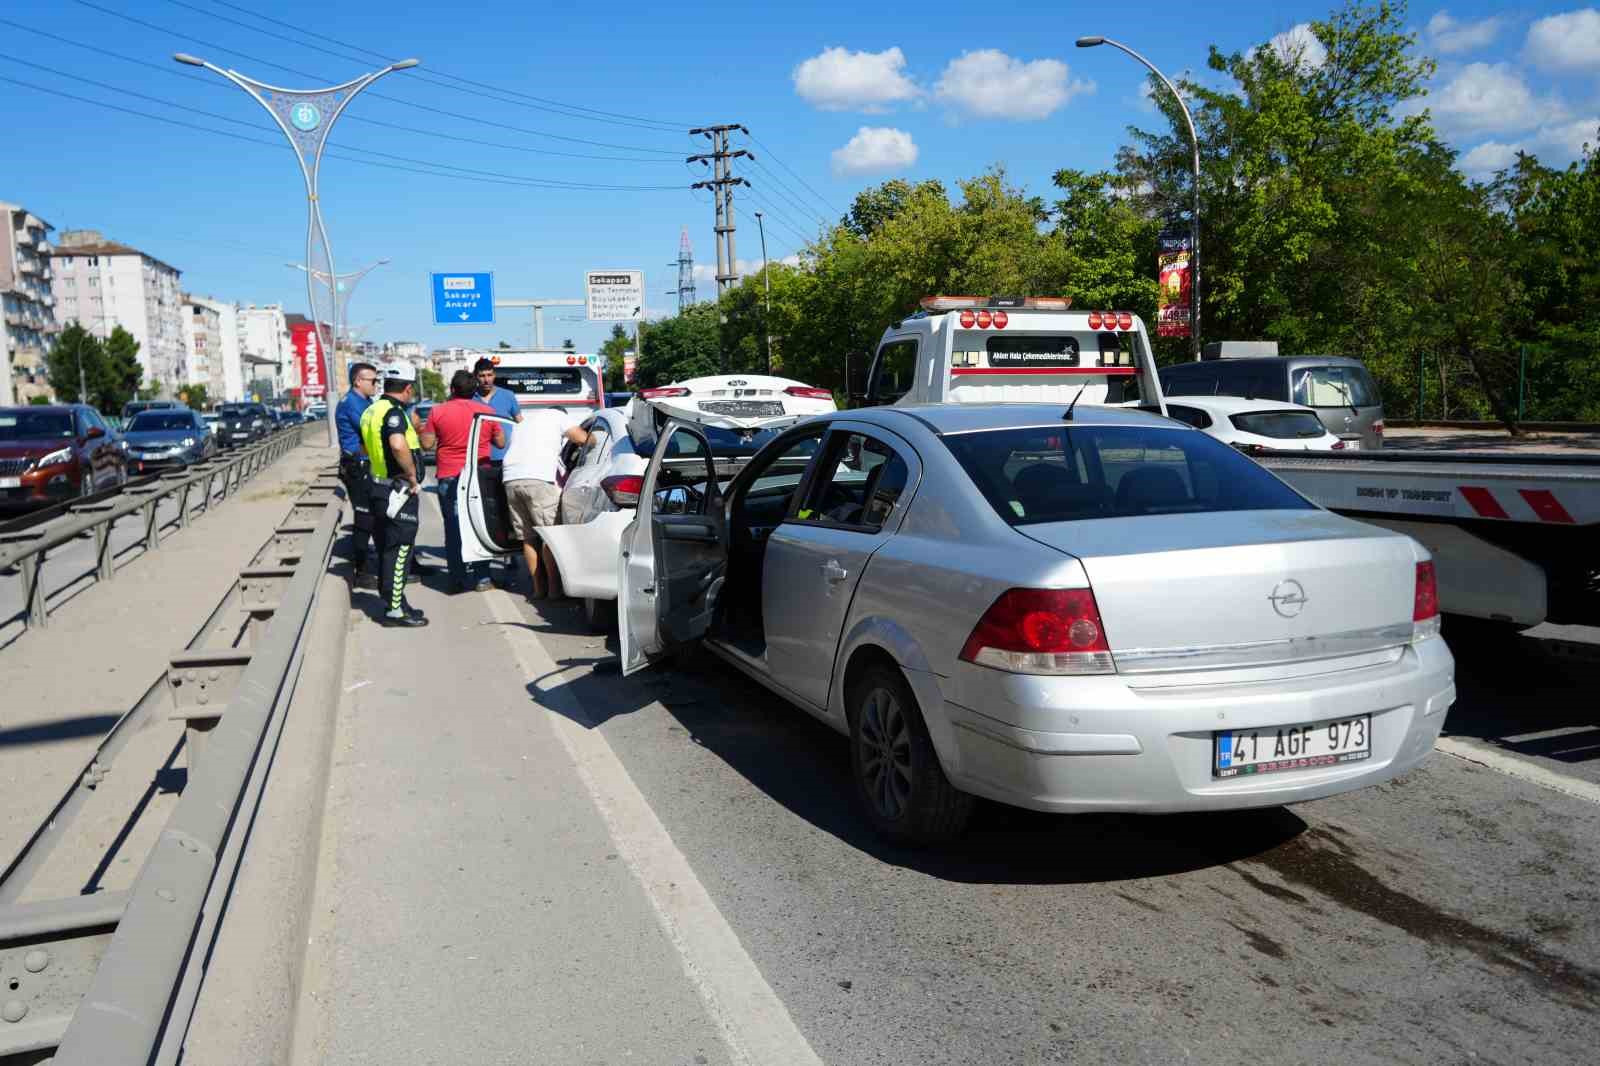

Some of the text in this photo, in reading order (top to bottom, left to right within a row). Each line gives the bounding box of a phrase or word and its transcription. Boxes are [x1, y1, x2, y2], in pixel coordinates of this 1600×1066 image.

[444, 292, 480, 300] Sakarya
[1234, 720, 1364, 761] 41 AGF 973
